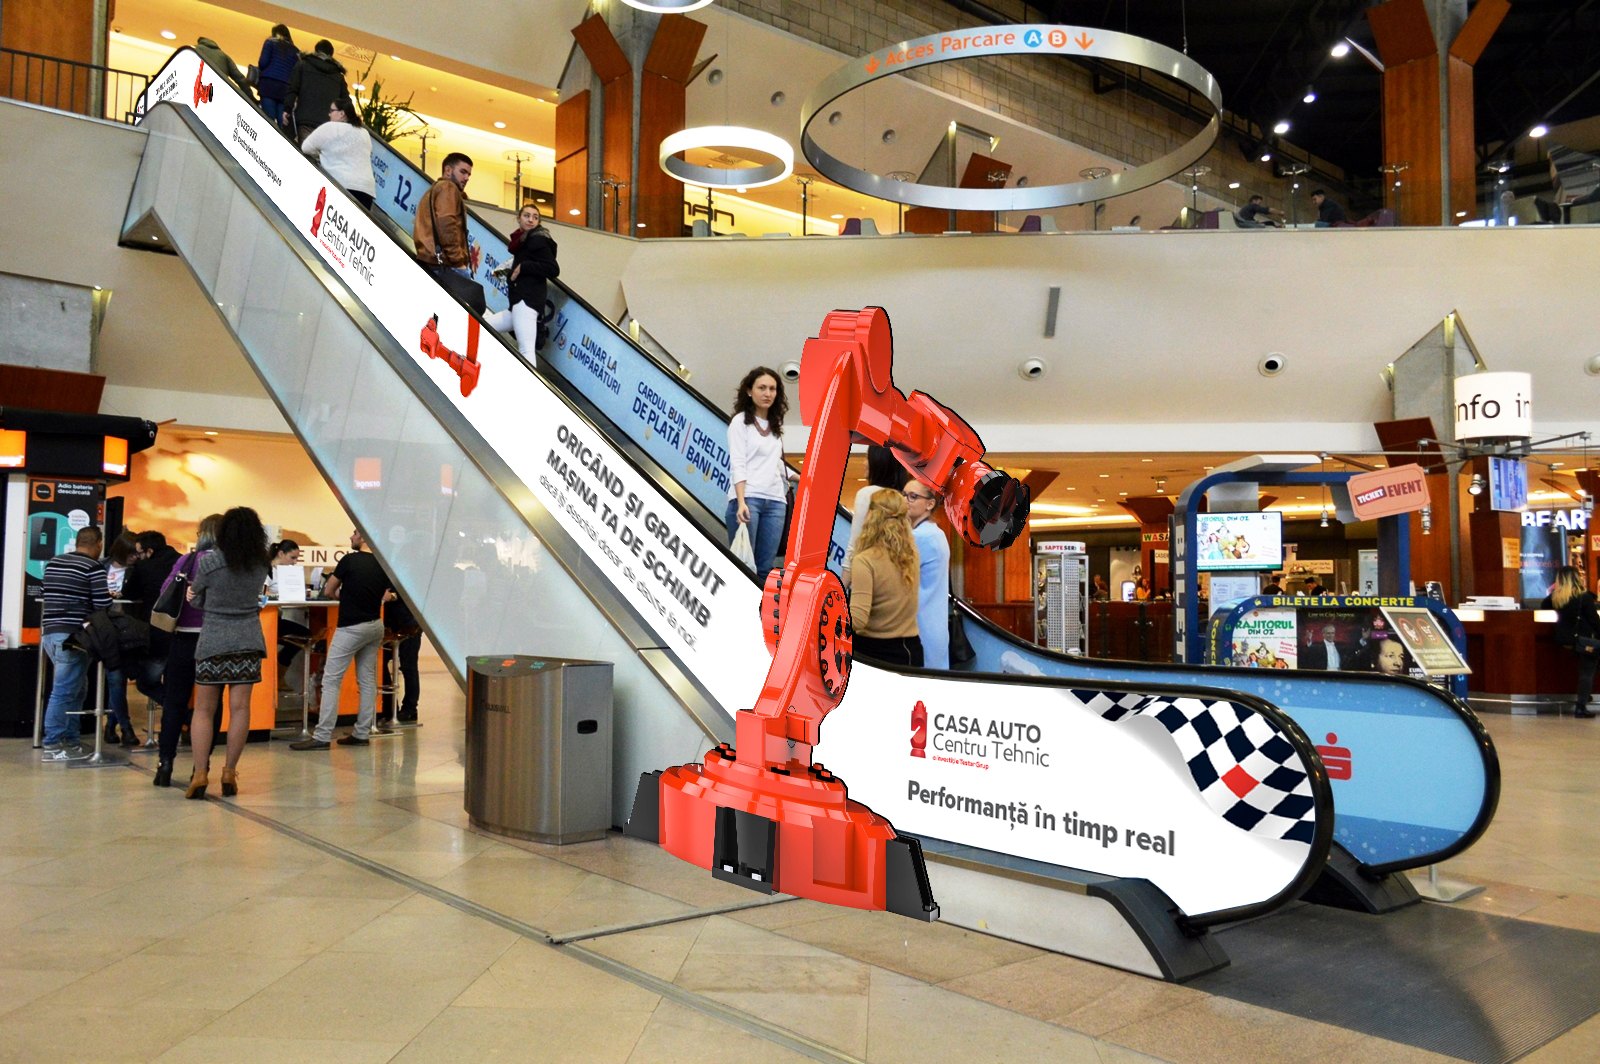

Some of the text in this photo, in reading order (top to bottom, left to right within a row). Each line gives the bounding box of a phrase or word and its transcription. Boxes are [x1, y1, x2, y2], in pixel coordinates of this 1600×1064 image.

[884, 43, 935, 67] Acces
[941, 32, 1016, 55] Parcare
[394, 174, 412, 212] 12
[322, 221, 348, 258] Centru
[348, 245, 375, 287] Tehnic
[327, 204, 349, 239] CASA
[348, 228, 376, 263] AUTO
[569, 343, 622, 396] CUMPĂRĂTURI
[580, 333, 618, 375] LUNAR LA
[632, 396, 681, 450] DE PLATĂ
[637, 381, 687, 431] CARDUL BUN
[686, 445, 712, 477] BANI
[556, 424, 728, 597] ORICÂND ȘI GRATUIT
[1356, 479, 1423, 505] TICKET EVENT
[311, 550, 328, 563] IN
[546, 448, 713, 630] MAȘINA TA DE SCHIMB
[1272, 596, 1415, 607] BILETE LA CONCERTE
[934, 713, 1041, 744] CASA AUTO
[933, 733, 1050, 768] Centru Tehnic
[907, 779, 1176, 857] Performanță în timp real
